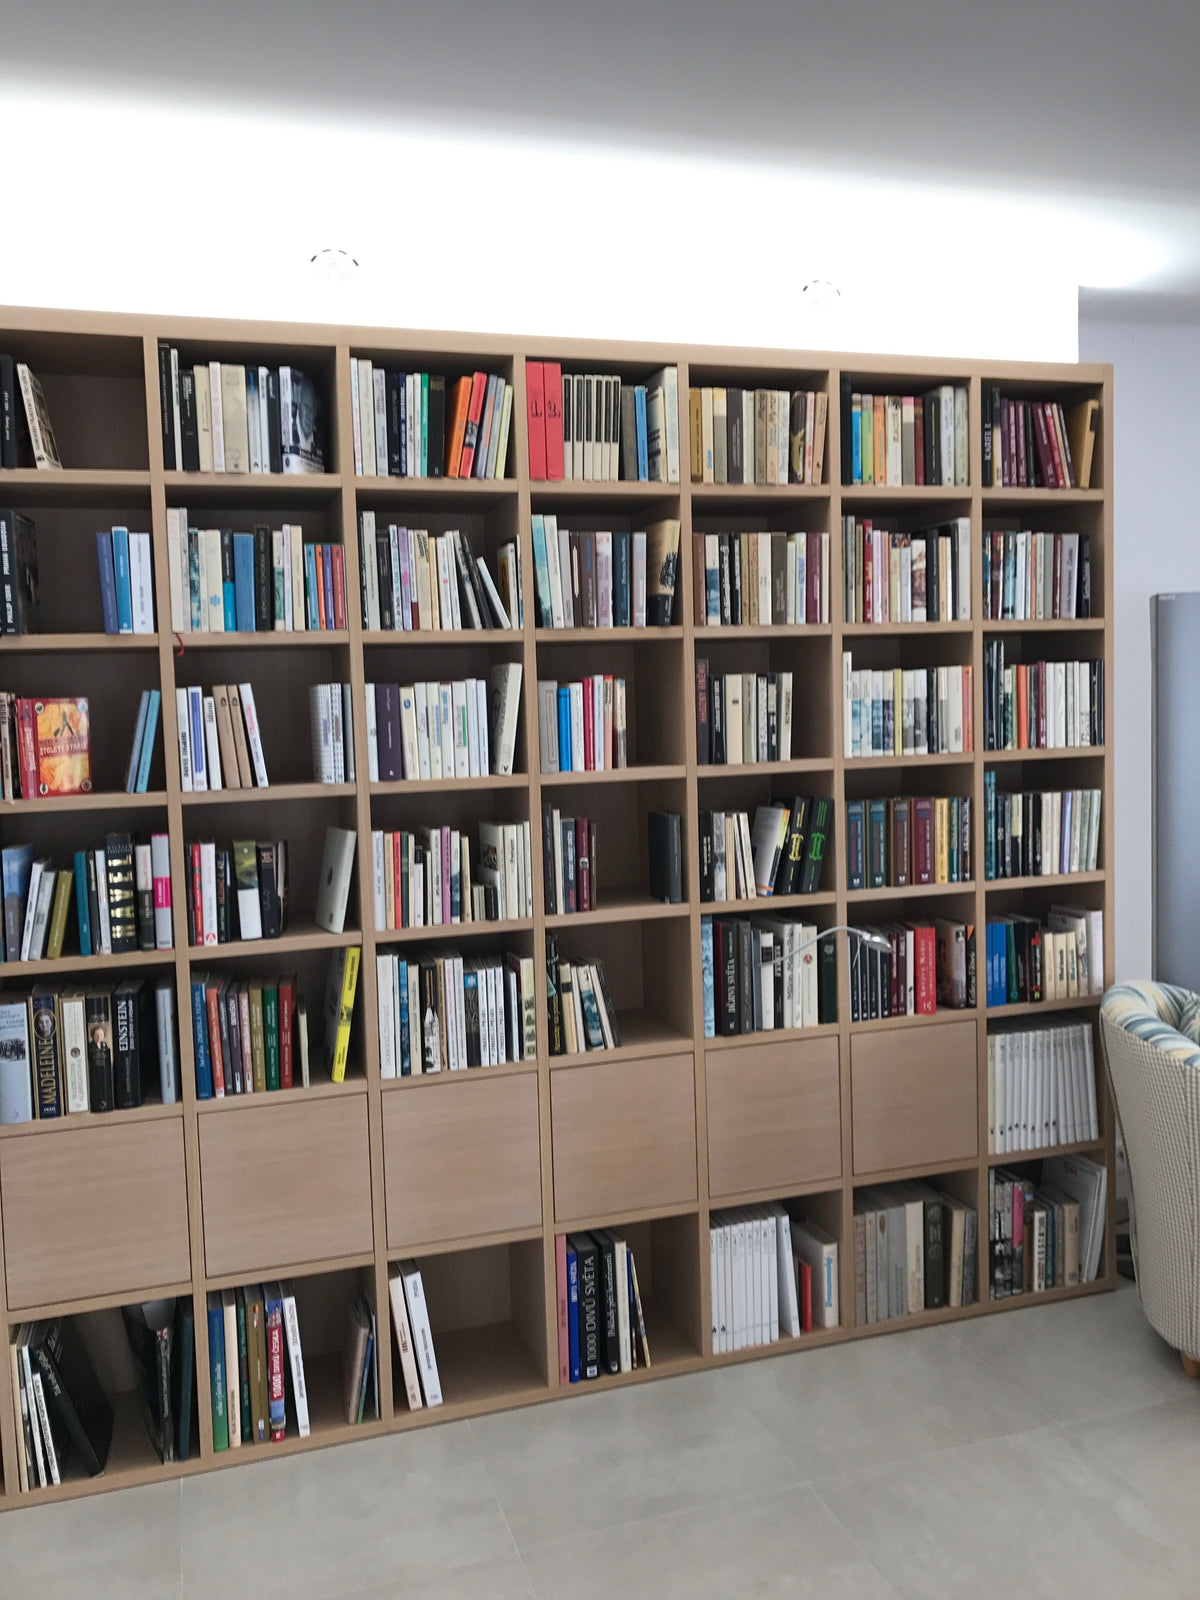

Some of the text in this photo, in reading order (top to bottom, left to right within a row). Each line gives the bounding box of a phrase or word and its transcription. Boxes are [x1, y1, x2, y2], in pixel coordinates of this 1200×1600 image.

[984, 430, 992, 460] KAREL
[6, 602, 14, 624] PHILIP
[108, 854, 136, 938] HAVEL
[726, 958, 736, 1013] DĚJINY SVĚTA
[117, 1000, 128, 1052] EINSTEIN
[38, 1038, 56, 1104] MADELEINE
[582, 1255, 597, 1362] 1000 DIVŮ SVĚTA
[272, 1329, 280, 1354] ČESKA
[272, 1374, 281, 1399] 1000
